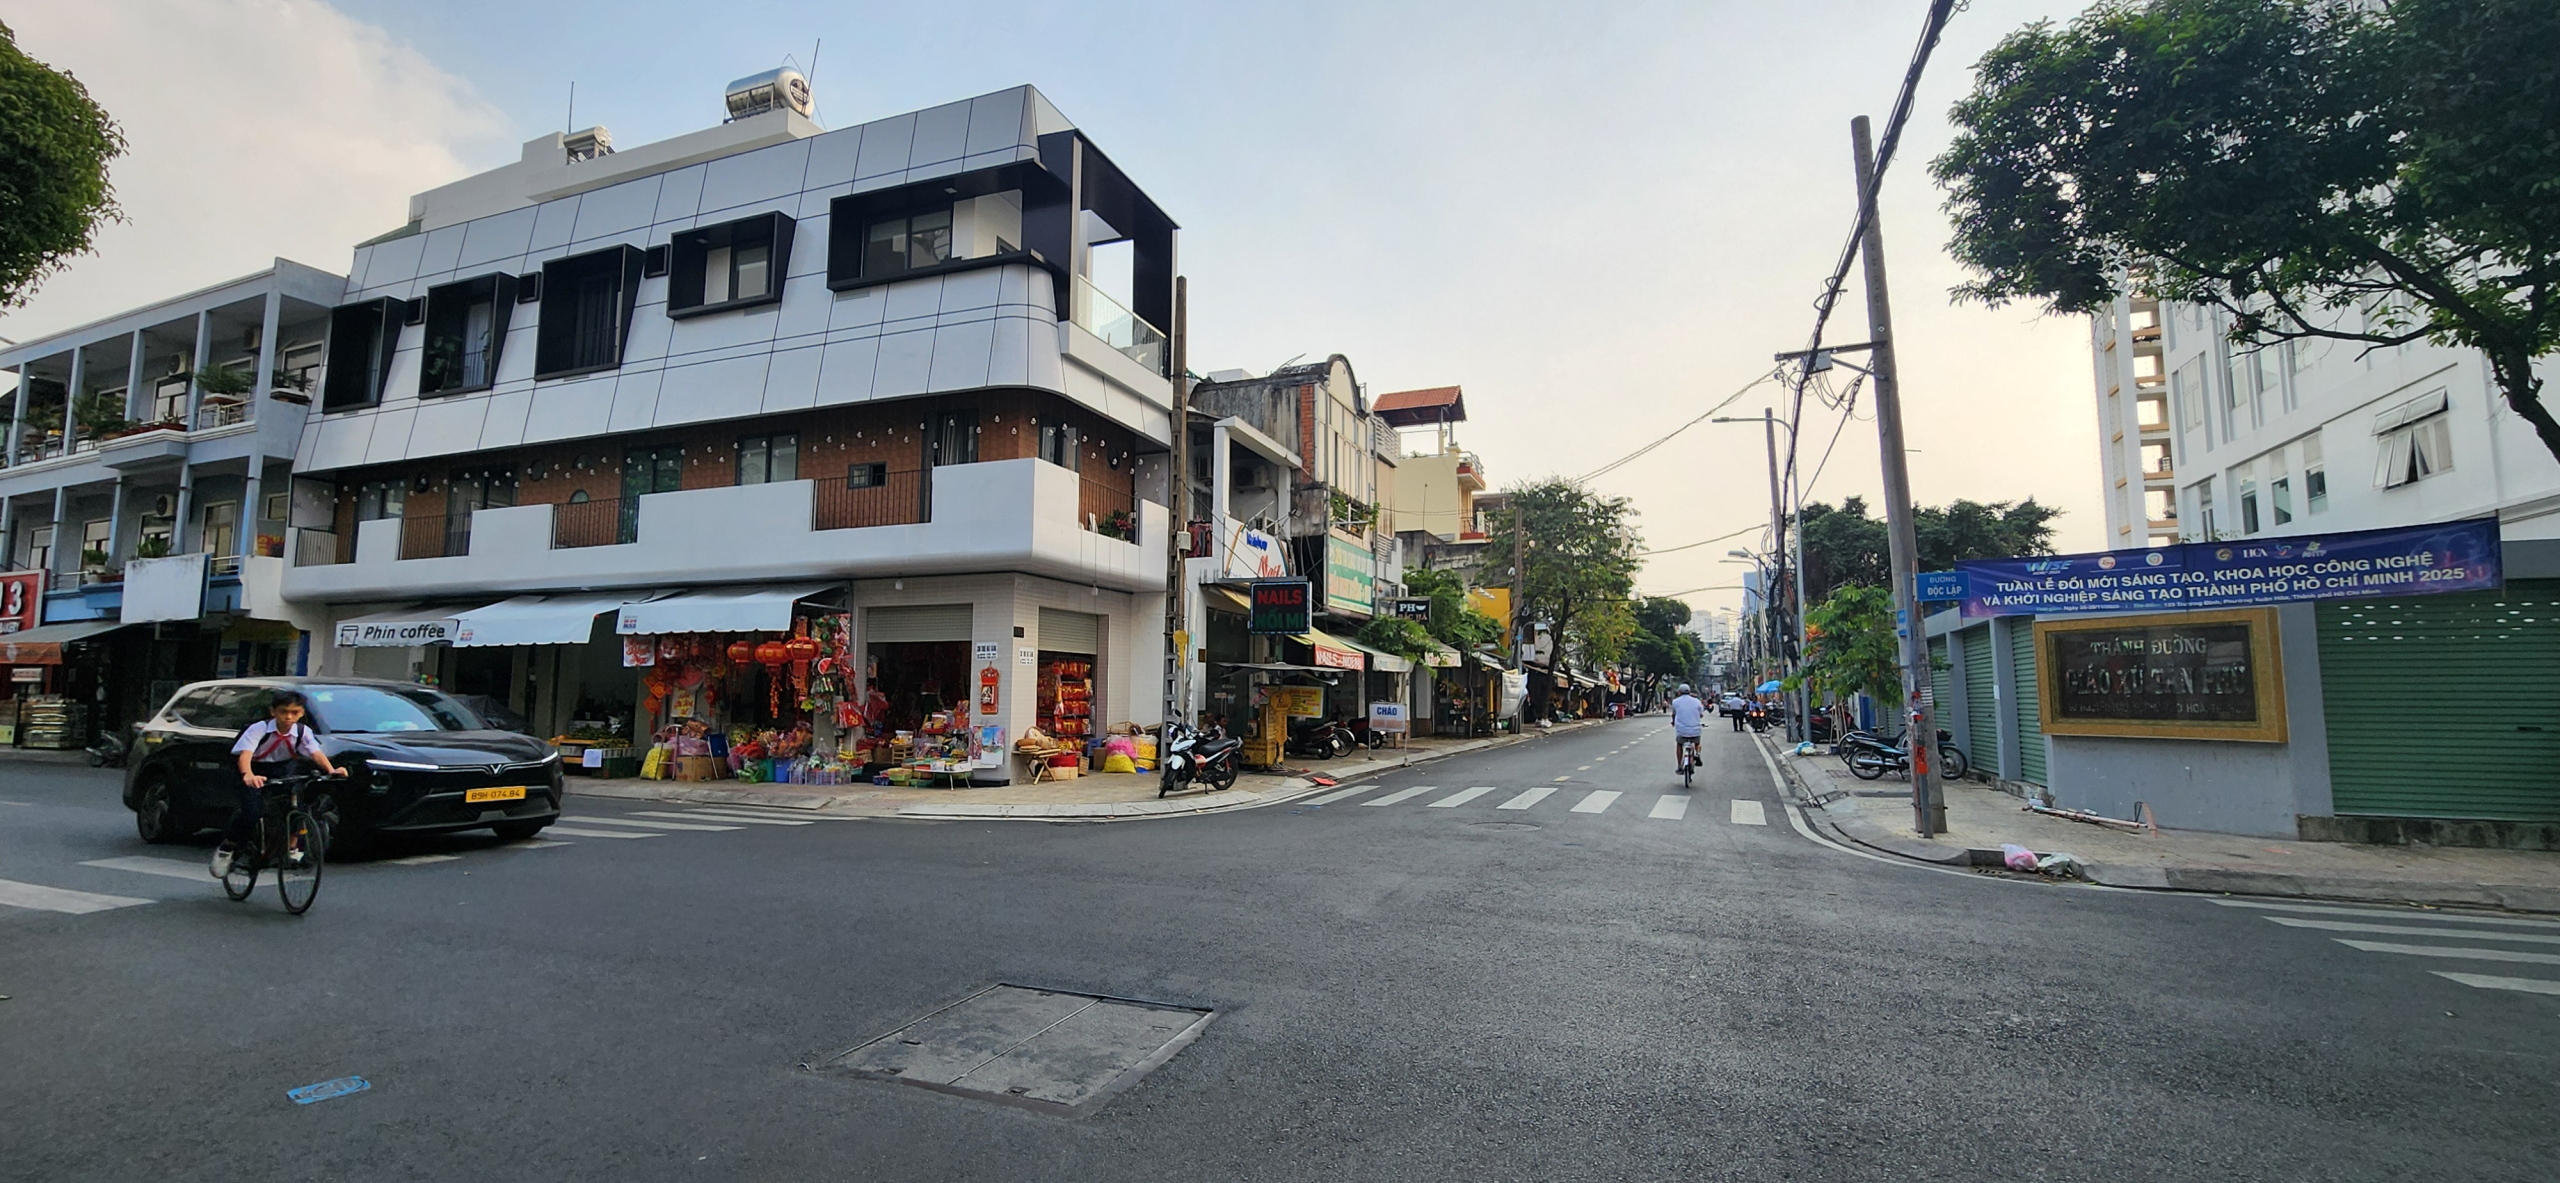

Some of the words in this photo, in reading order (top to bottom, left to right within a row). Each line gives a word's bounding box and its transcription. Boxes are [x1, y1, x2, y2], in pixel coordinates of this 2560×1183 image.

[1996, 579, 2034, 593] TUẦN
[2037, 576, 2055, 591] LỄ
[2057, 576, 2084, 590] ĐỔI
[2088, 574, 2118, 588] MỚI
[2121, 572, 2166, 587] SÁNG
[2170, 571, 2209, 586] TẠO,
[2214, 564, 2264, 581] KHOA
[2268, 562, 2308, 580] HỌC
[2313, 557, 2370, 574] CÔNG
[2376, 551, 2434, 569] NGHỆ
[1927, 584, 1944, 598] ĐỘC
[1946, 583, 1963, 597] LẬP
[1983, 594, 2001, 607] VÀ
[2004, 591, 2040, 607] KHỞI
[2043, 590, 2098, 605] NGHIỆP
[2101, 587, 2145, 602] SÁNG
[2148, 586, 2183, 602] TẠO
[2186, 580, 2245, 598] THÀNH
[2250, 577, 2289, 594] PHỐ
[2293, 574, 2321, 592] HỒ
[2326, 571, 2358, 588] CHÍ
[2364, 570, 2413, 586] MINH
[2419, 567, 2465, 583] 2025
[1257, 589, 1303, 605] NAILS
[1286, 612, 1304, 629] MI
[364, 625, 396, 639] Phin
[400, 624, 446, 639] coffee
[2090, 637, 2146, 656] THÁNH
[2151, 634, 2207, 655] ĐƯỜNG
[1376, 705, 1398, 716] CHÁO
